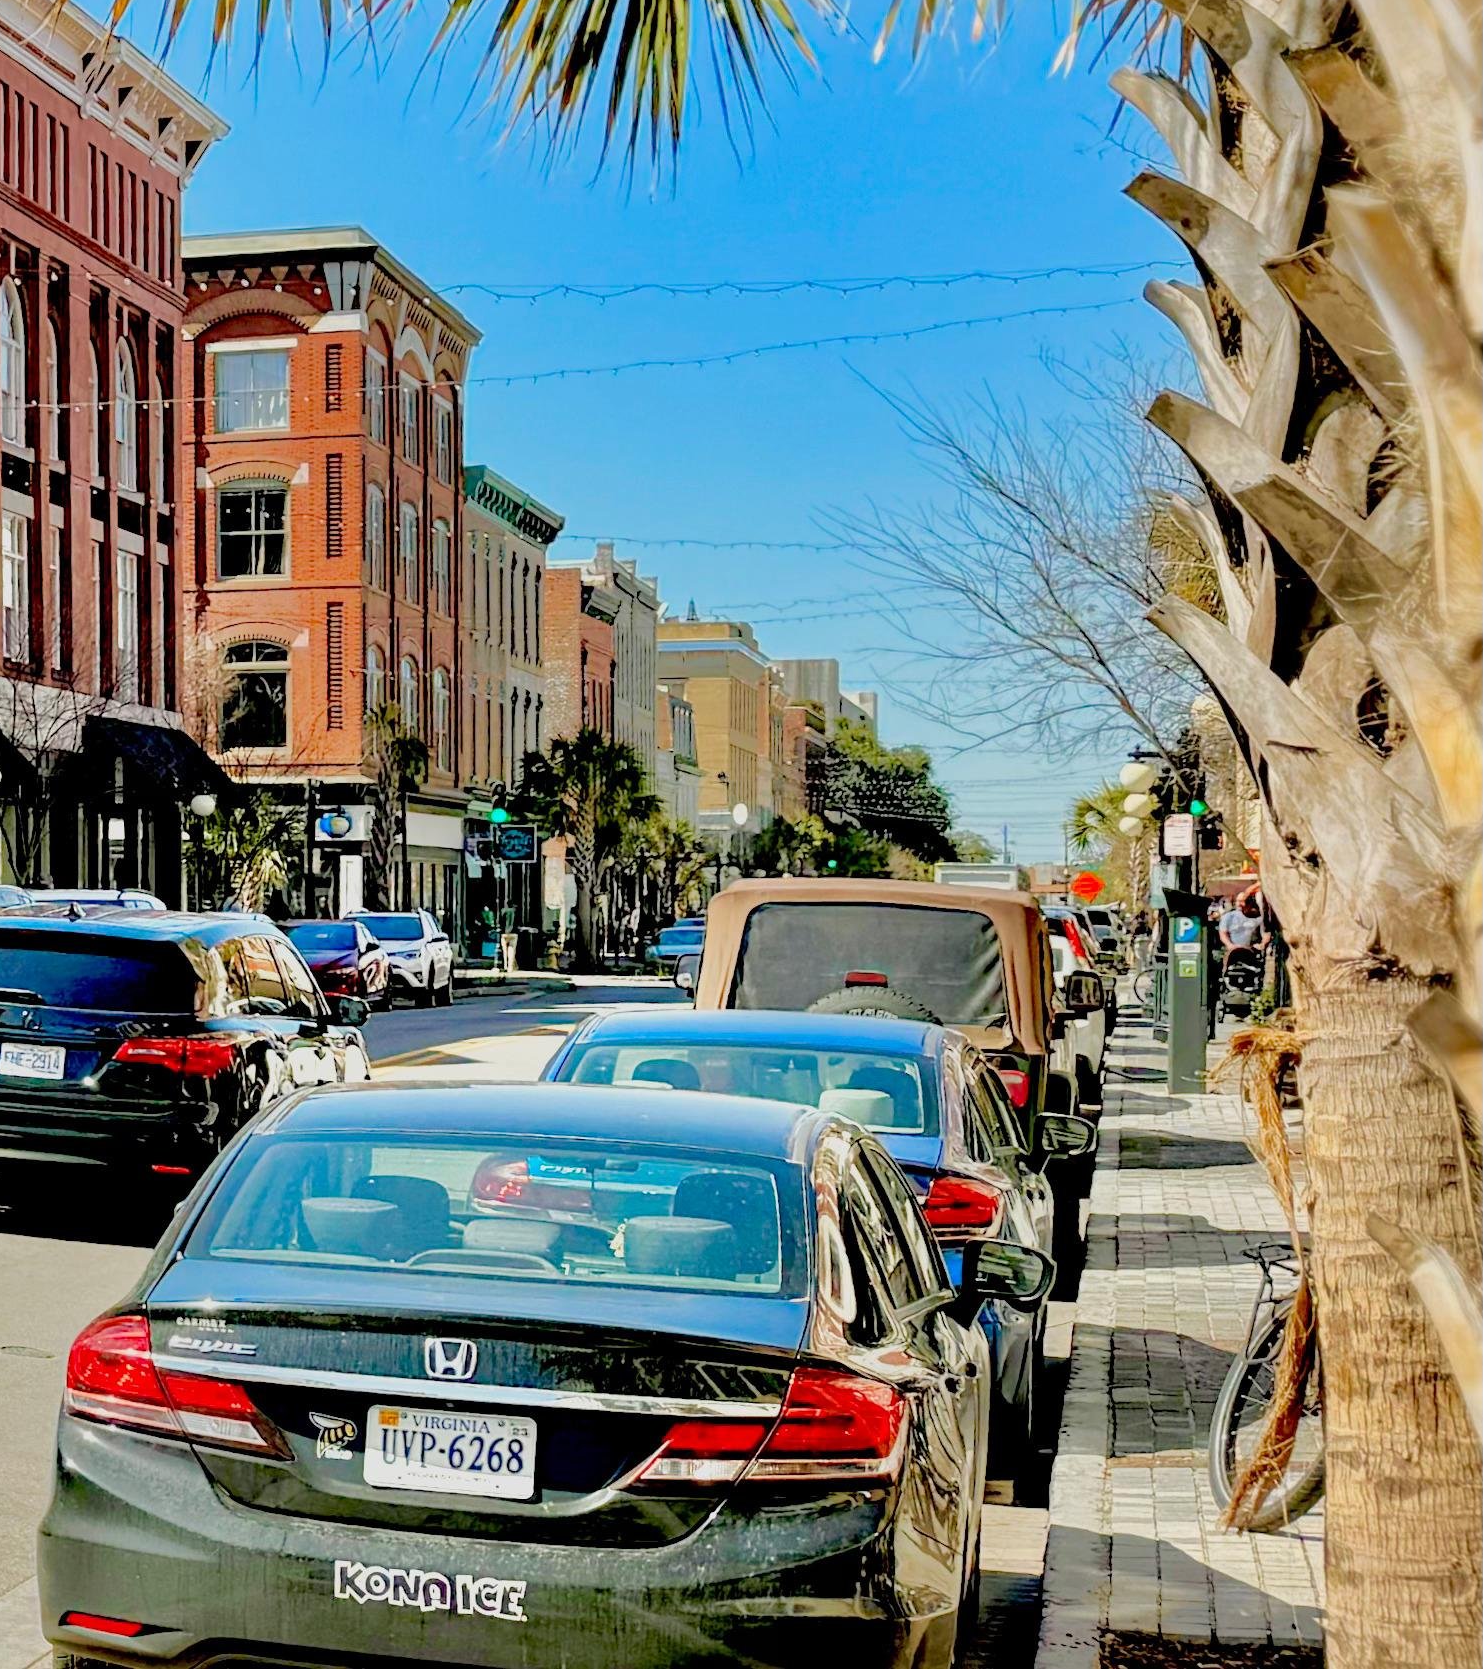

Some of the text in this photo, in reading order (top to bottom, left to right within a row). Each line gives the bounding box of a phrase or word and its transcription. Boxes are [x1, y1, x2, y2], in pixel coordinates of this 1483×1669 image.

[1178, 916, 1194, 937] P
[411, 1414, 491, 1435] VIRGINIA
[381, 1428, 524, 1474] UVP-6268
[334, 1559, 528, 1623] KONA ICE
